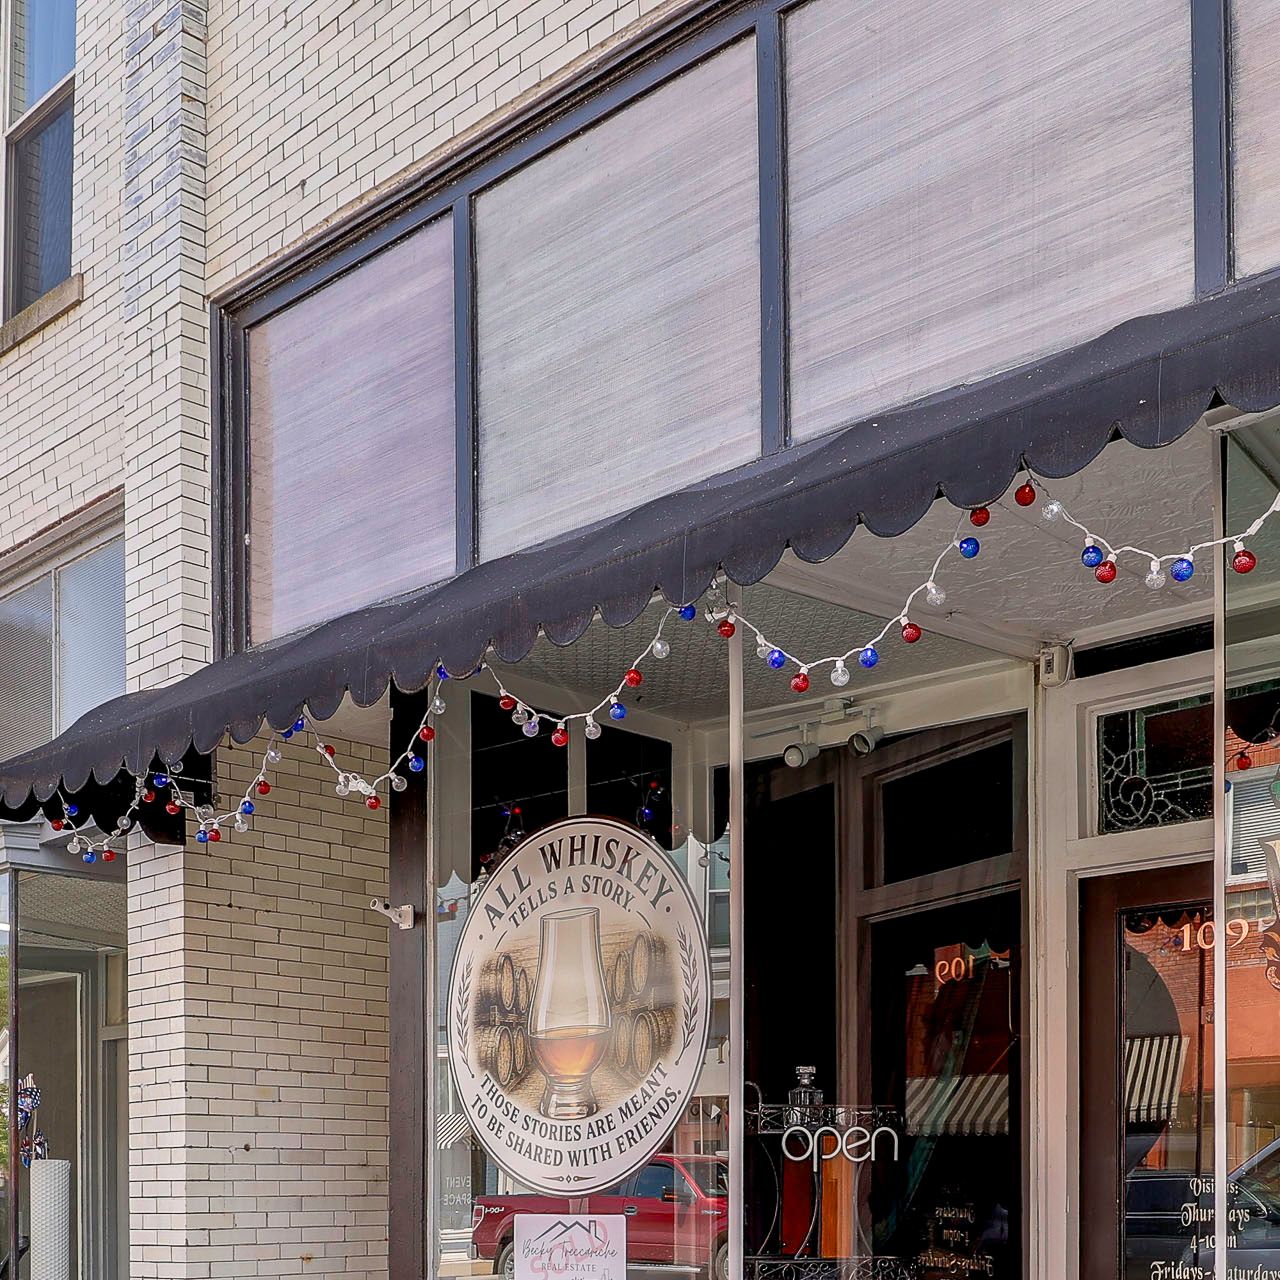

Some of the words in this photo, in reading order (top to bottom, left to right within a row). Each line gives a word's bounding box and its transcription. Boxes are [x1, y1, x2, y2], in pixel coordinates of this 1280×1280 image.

[482, 864, 532, 931] ALL
[538, 833, 675, 911] WHISKEY
[507, 880, 559, 929] TELLS
[563, 875, 575, 895] A
[581, 874, 637, 913] STORY.
[1180, 917, 1250, 952] 109
[480, 1072, 520, 1125] THOSE
[521, 1116, 583, 1143] STORIES
[586, 1112, 617, 1140] ARE
[617, 1060, 670, 1123] MEANT
[470, 1094, 488, 1120] TO
[486, 1113, 504, 1140] BE
[505, 1130, 564, 1167] SHARED
[566, 1141, 614, 1168] WITH
[615, 1084, 683, 1156] FRIENDS.
[780, 1125, 900, 1174] open
[1189, 1178, 1216, 1197] Visi
[1180, 1202, 1251, 1231] Thurays
[1190, 1234, 1237, 1254] 4-10m
[541, 1262, 562, 1271] REAL
[564, 1263, 597, 1272] ESTATE
